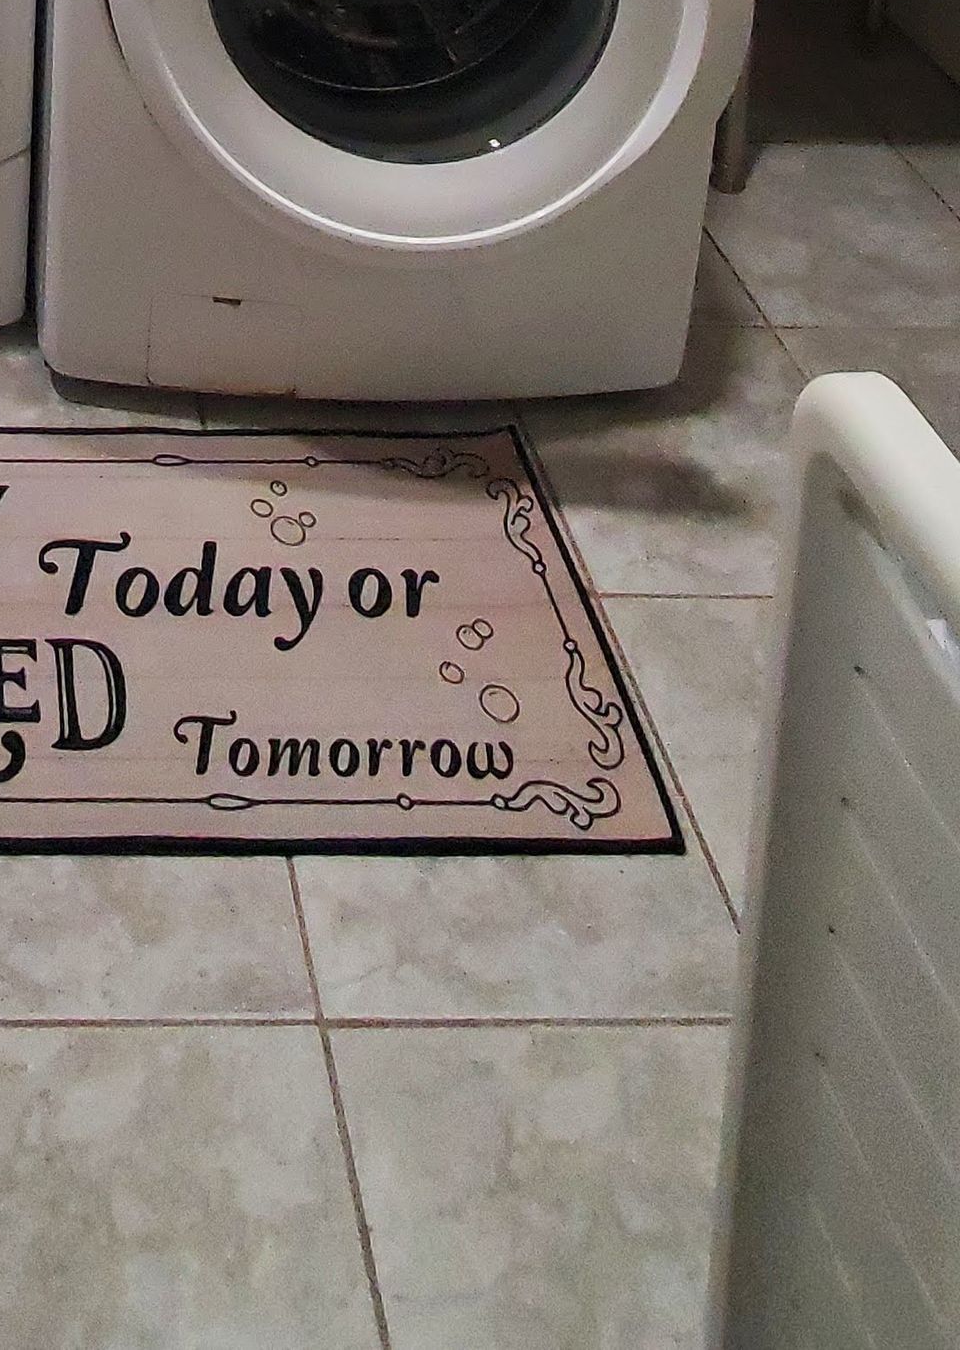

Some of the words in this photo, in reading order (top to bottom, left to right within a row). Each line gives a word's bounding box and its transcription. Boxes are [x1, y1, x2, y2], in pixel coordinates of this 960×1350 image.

[39, 532, 324, 652] Today
[347, 566, 440, 619] or
[173, 710, 514, 780] Tomorrow
